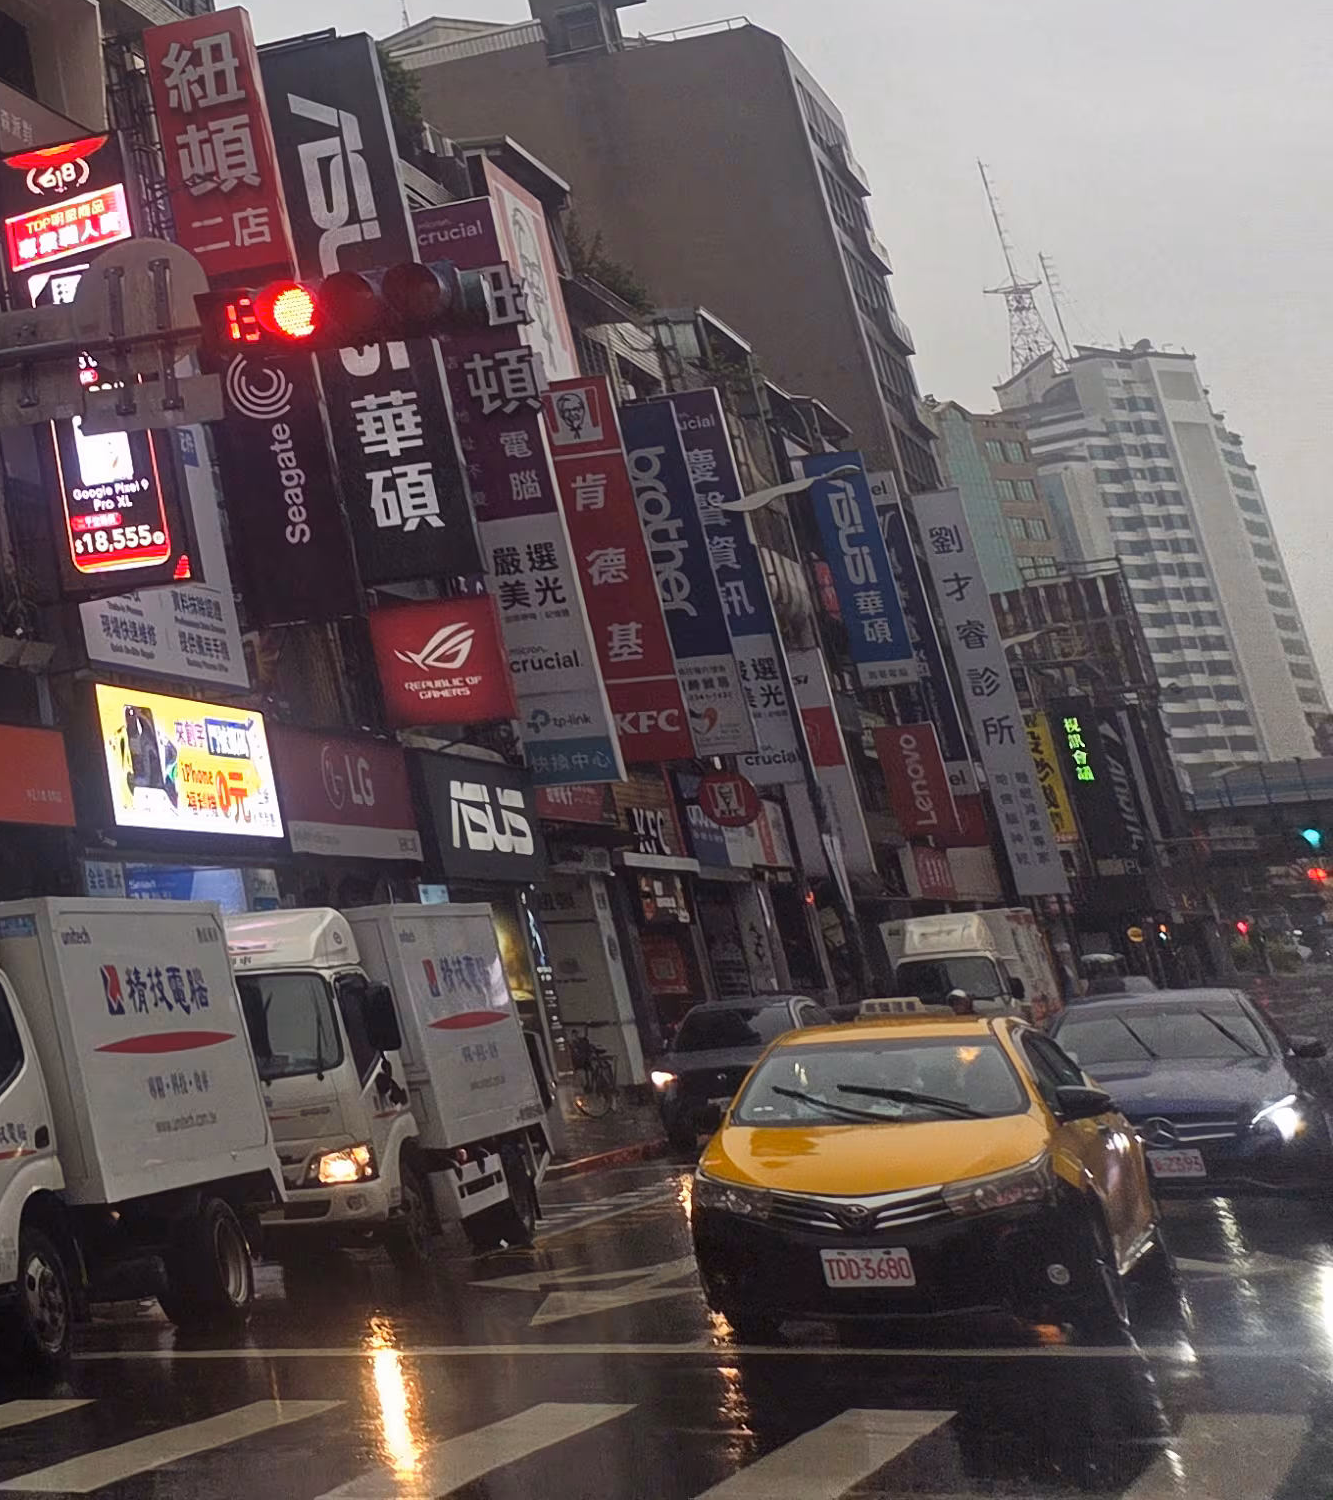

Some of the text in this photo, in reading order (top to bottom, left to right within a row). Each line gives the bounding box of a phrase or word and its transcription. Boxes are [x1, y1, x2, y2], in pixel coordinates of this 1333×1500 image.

[159, 31, 263, 200] 紐頓
[190, 207, 272, 256] 二店
[417, 219, 484, 247] crucial
[269, 422, 311, 545] Seagate
[349, 389, 446, 532] 華碩
[72, 484, 113, 501] Google
[115, 480, 140, 495] Pixel
[93, 494, 133, 512] Pro XL
[627, 445, 698, 617] brother
[492, 541, 560, 577] 嚴選
[570, 473, 645, 662] 肯德基
[827, 479, 894, 644] ASUS 華碩
[499, 575, 566, 611] 美光
[929, 522, 1017, 748] 劉才睿診所
[404, 676, 482, 694] REPUBLIC OF
[419, 685, 471, 700] GAMERS
[616, 707, 682, 738] KFC
[344, 754, 375, 807] LG
[899, 733, 938, 827] Lenovo
[449, 780, 534, 856] ASUS
[61, 926, 92, 945] unitech
[125, 965, 210, 1016] 精技電腦
[824, 1256, 912, 1281] TDD-3680
